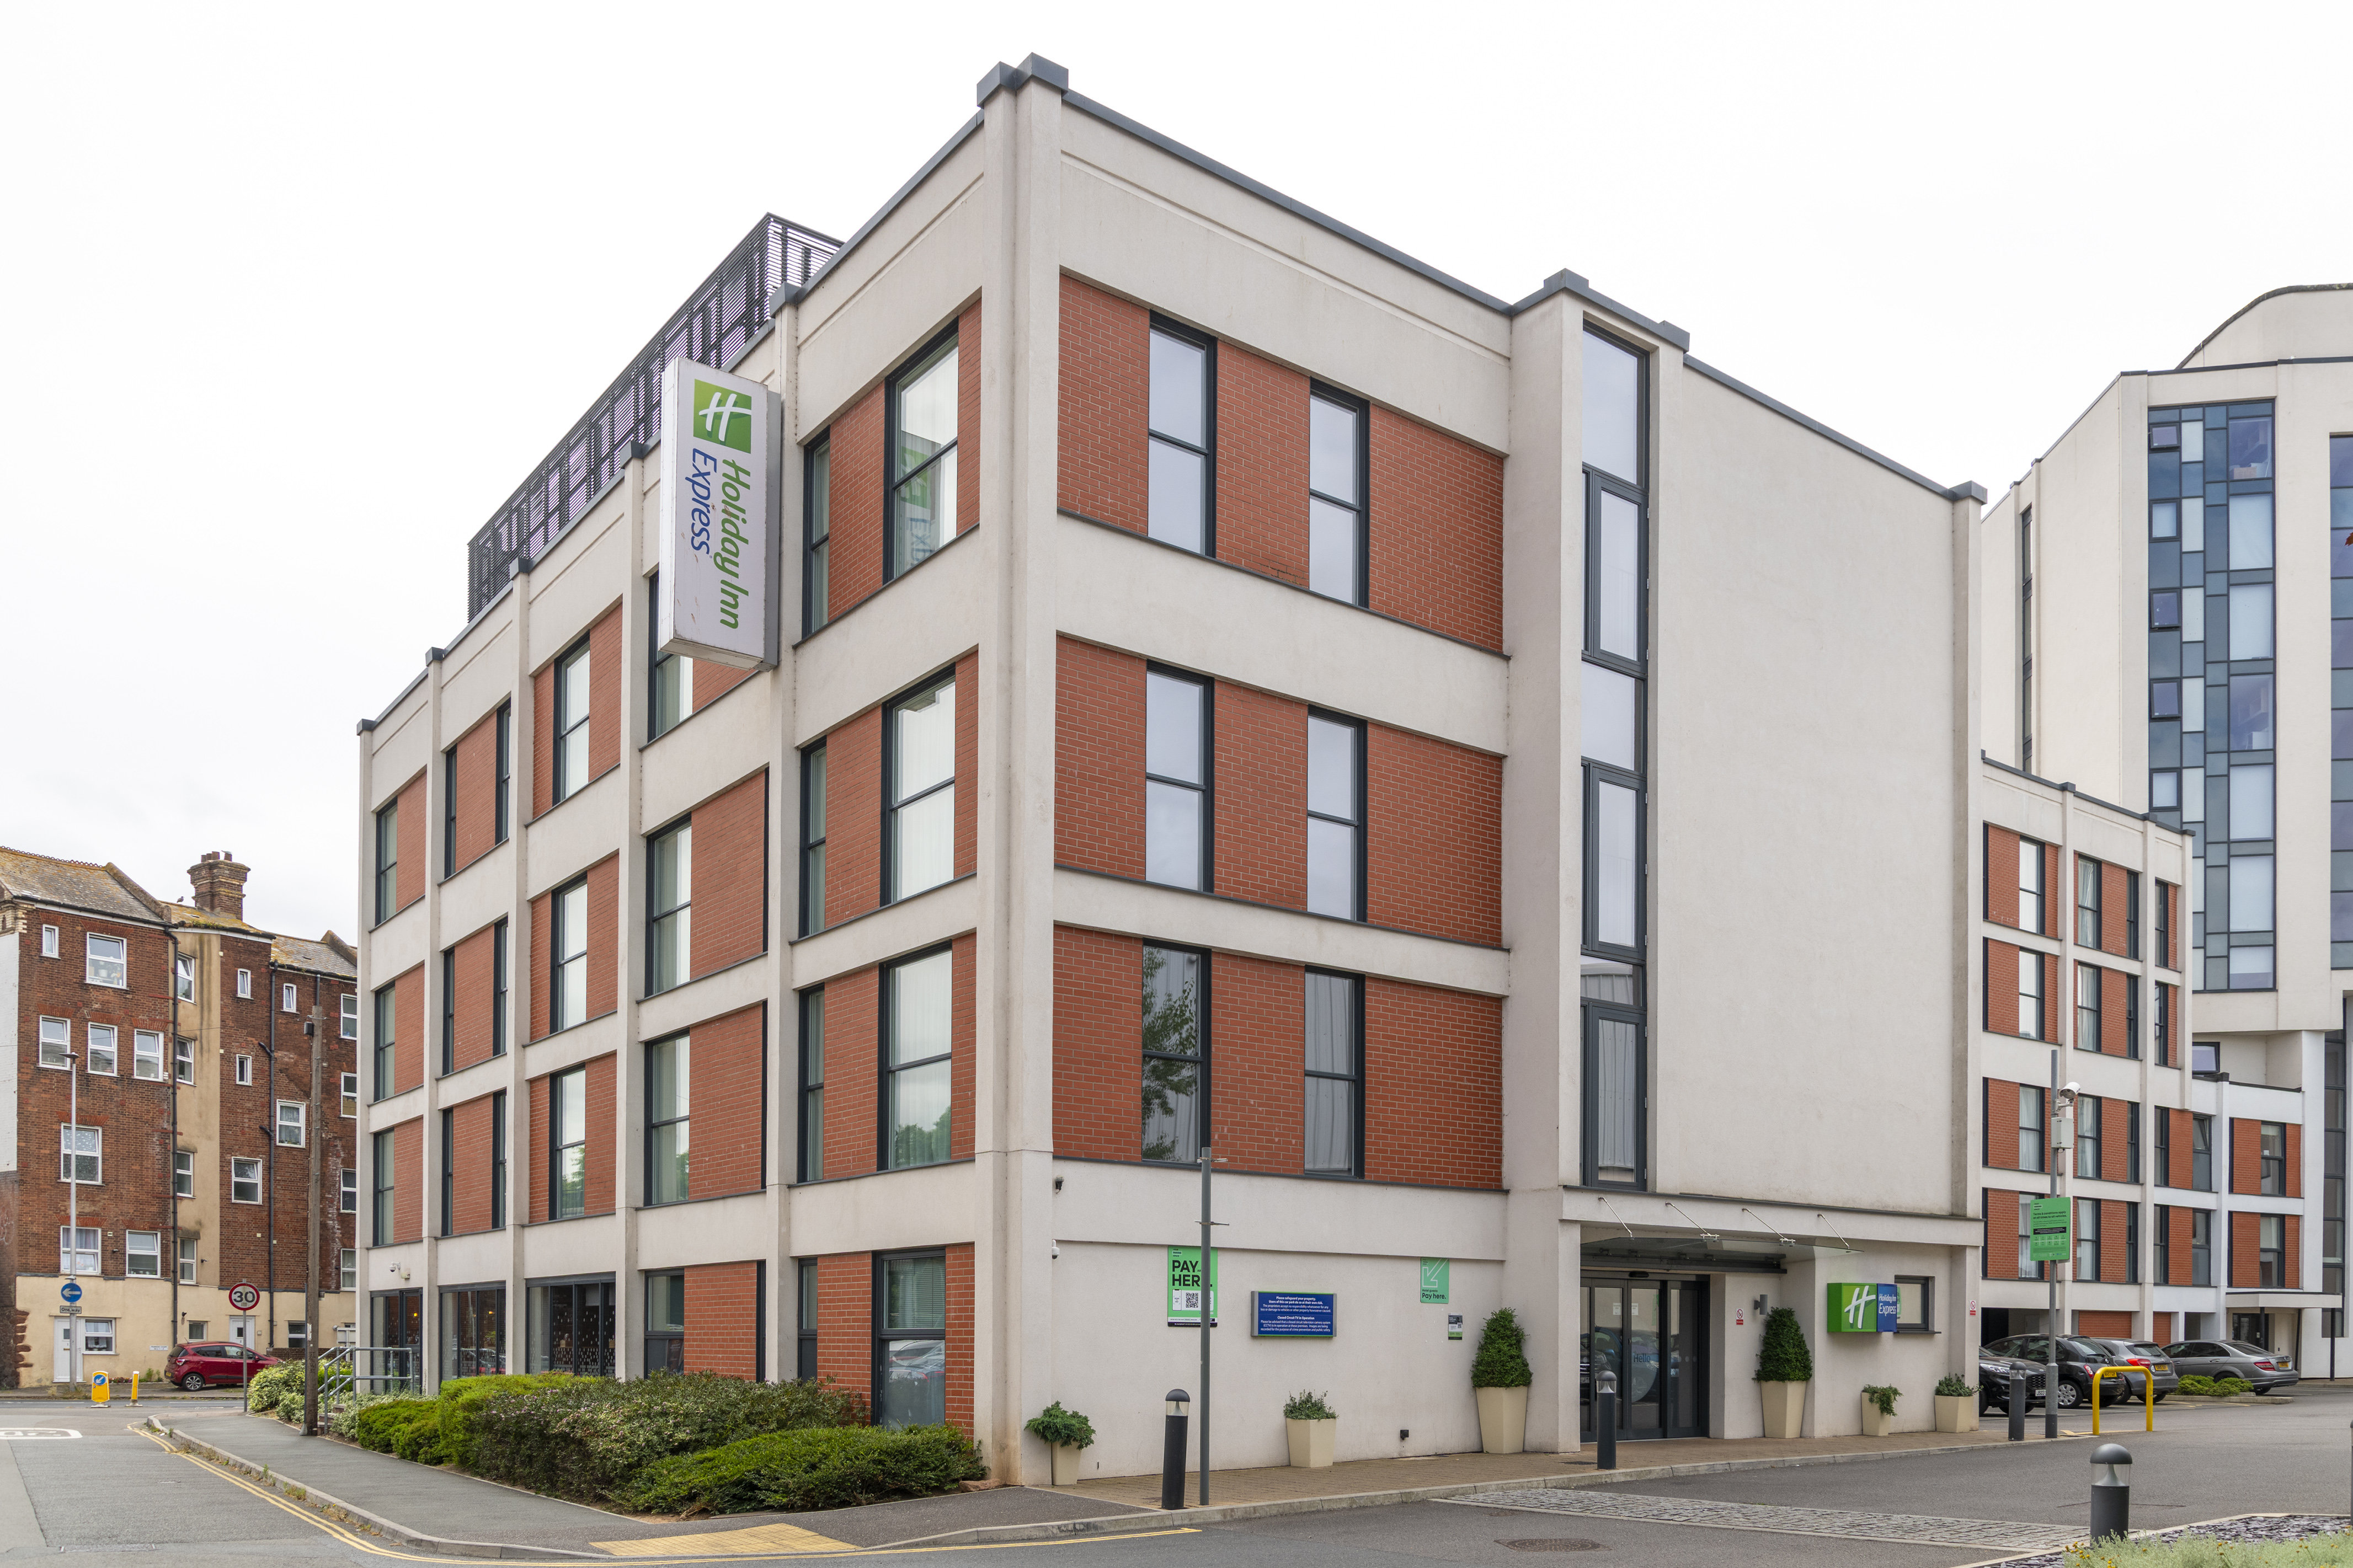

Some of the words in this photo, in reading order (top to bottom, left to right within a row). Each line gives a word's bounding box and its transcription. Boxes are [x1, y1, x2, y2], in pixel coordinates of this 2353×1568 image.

[685, 448, 717, 555] Express
[713, 459, 751, 579] Holiday
[720, 579, 749, 629] Inn
[1172, 1260, 1199, 1272] PAY
[1172, 1274, 1212, 1287] HER.
[233, 1291, 255, 1303] 30
[1879, 1293, 1892, 1303] Holiday
[1879, 1303, 1896, 1317] Express
[1634, 1353, 1651, 1363] Hello
